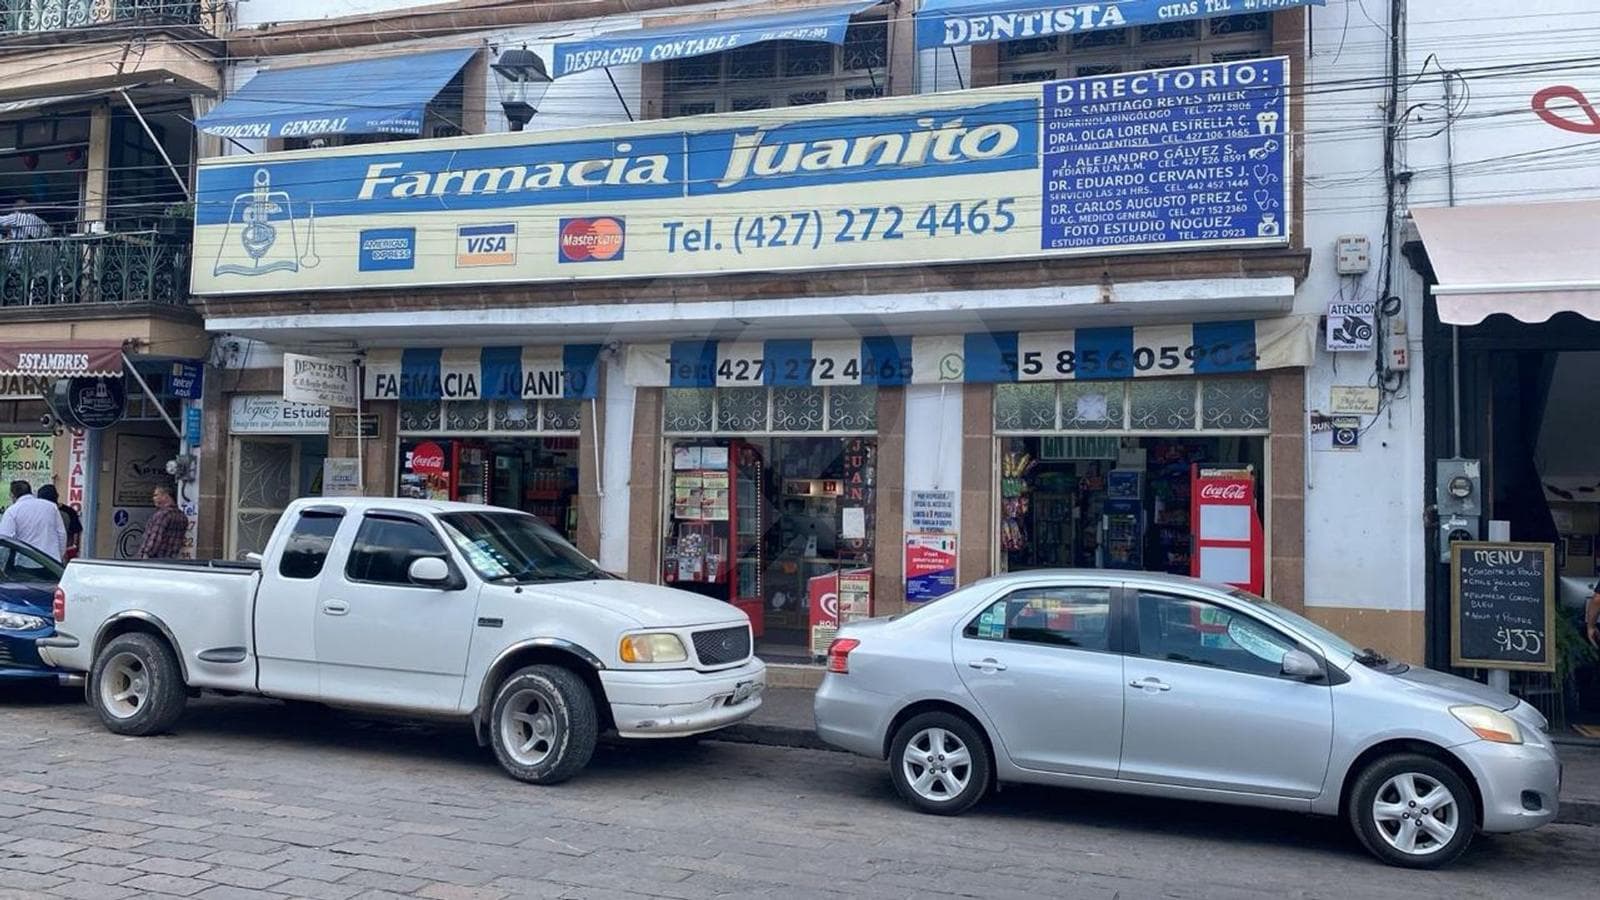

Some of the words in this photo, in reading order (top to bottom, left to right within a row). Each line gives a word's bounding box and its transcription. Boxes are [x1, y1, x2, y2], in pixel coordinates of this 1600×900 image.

[1158, 3, 1198, 18] CITAS
[943, 5, 1126, 46] DENTISTA
[564, 46, 642, 74] DESPACHO
[650, 32, 741, 61] CONTABLE
[1081, 98, 1152, 115] SANTIAGO
[1157, 95, 1202, 109] REYES
[1207, 104, 1224, 114] 272
[279, 116, 349, 136] GENERAL
[1049, 132, 1078, 145] DRA.
[1081, 128, 1114, 142] OLGA
[1118, 122, 1168, 138] LORENA
[1172, 116, 1234, 132] ESTRELLA
[1238, 114, 1251, 127] C.
[1102, 137, 1149, 149] DENTISTA
[1186, 131, 1202, 141] 427
[1206, 130, 1223, 140] 106
[357, 143, 671, 201] Farmacia
[715, 117, 1019, 189] Juanito
[1052, 166, 1100, 178] PEDIATRA
[1102, 162, 1146, 173] U.N.A.M.
[1182, 157, 1199, 166] 427
[1202, 155, 1220, 165] 226
[1222, 153, 1247, 163] 8591
[1061, 158, 1072, 169] J.
[1075, 151, 1159, 168] ALEJANDRO
[1164, 145, 1219, 160] GÁLVEZ
[1224, 144, 1237, 156] S.
[1049, 180, 1071, 191] DR.
[1076, 173, 1145, 189] EDUARDO
[1149, 166, 1233, 183] CERVANTES
[1238, 165, 1250, 177] J.
[1049, 191, 1093, 201] SERVICIO
[1095, 189, 1113, 198] LAS
[1116, 188, 1127, 197] 24
[1130, 186, 1153, 196] HRS.
[1051, 204, 1071, 216] DR.
[1075, 200, 1122, 214] CARLOS
[1126, 195, 1187, 210] AUGUSTO
[1190, 191, 1231, 206] PEREZ
[1235, 190, 1248, 203] C.
[1078, 213, 1114, 224] MEDICO
[1116, 210, 1158, 221] GENERAL
[1190, 206, 1206, 216] 427
[1208, 205, 1223, 215] 152
[1225, 204, 1248, 214] 2360
[662, 219, 723, 255] Tel.
[733, 209, 824, 255] (427)
[833, 205, 905, 244] 272
[914, 196, 1017, 238] 4465
[1064, 223, 1099, 237] FOTO
[1104, 219, 1165, 235] ESTUDIO
[1170, 215, 1233, 231] NOGUEZ
[363, 237, 409, 251] AMERICAN
[466, 236, 507, 254] VISA
[1051, 238, 1094, 249] ESTUDIO
[1096, 233, 1166, 245] FOTOGRAFICO
[1178, 231, 1199, 241] TEL.
[1201, 230, 1219, 240] 272
[1221, 228, 1246, 239] 0923
[371, 248, 411, 261] EXPRESS
[17, 353, 89, 370] ESTAMBRES
[294, 359, 348, 382] DENTISTA
[784, 357, 835, 381] 272
[842, 354, 915, 380] 4465
[999, 350, 1043, 377] 55
[375, 372, 478, 398] FARMACIA
[499, 369, 588, 397] JUANITO
[13, 437, 54, 460] SOLICITA
[2, 460, 51, 471] PERSONAL
[1474, 550, 1524, 567] MENU
